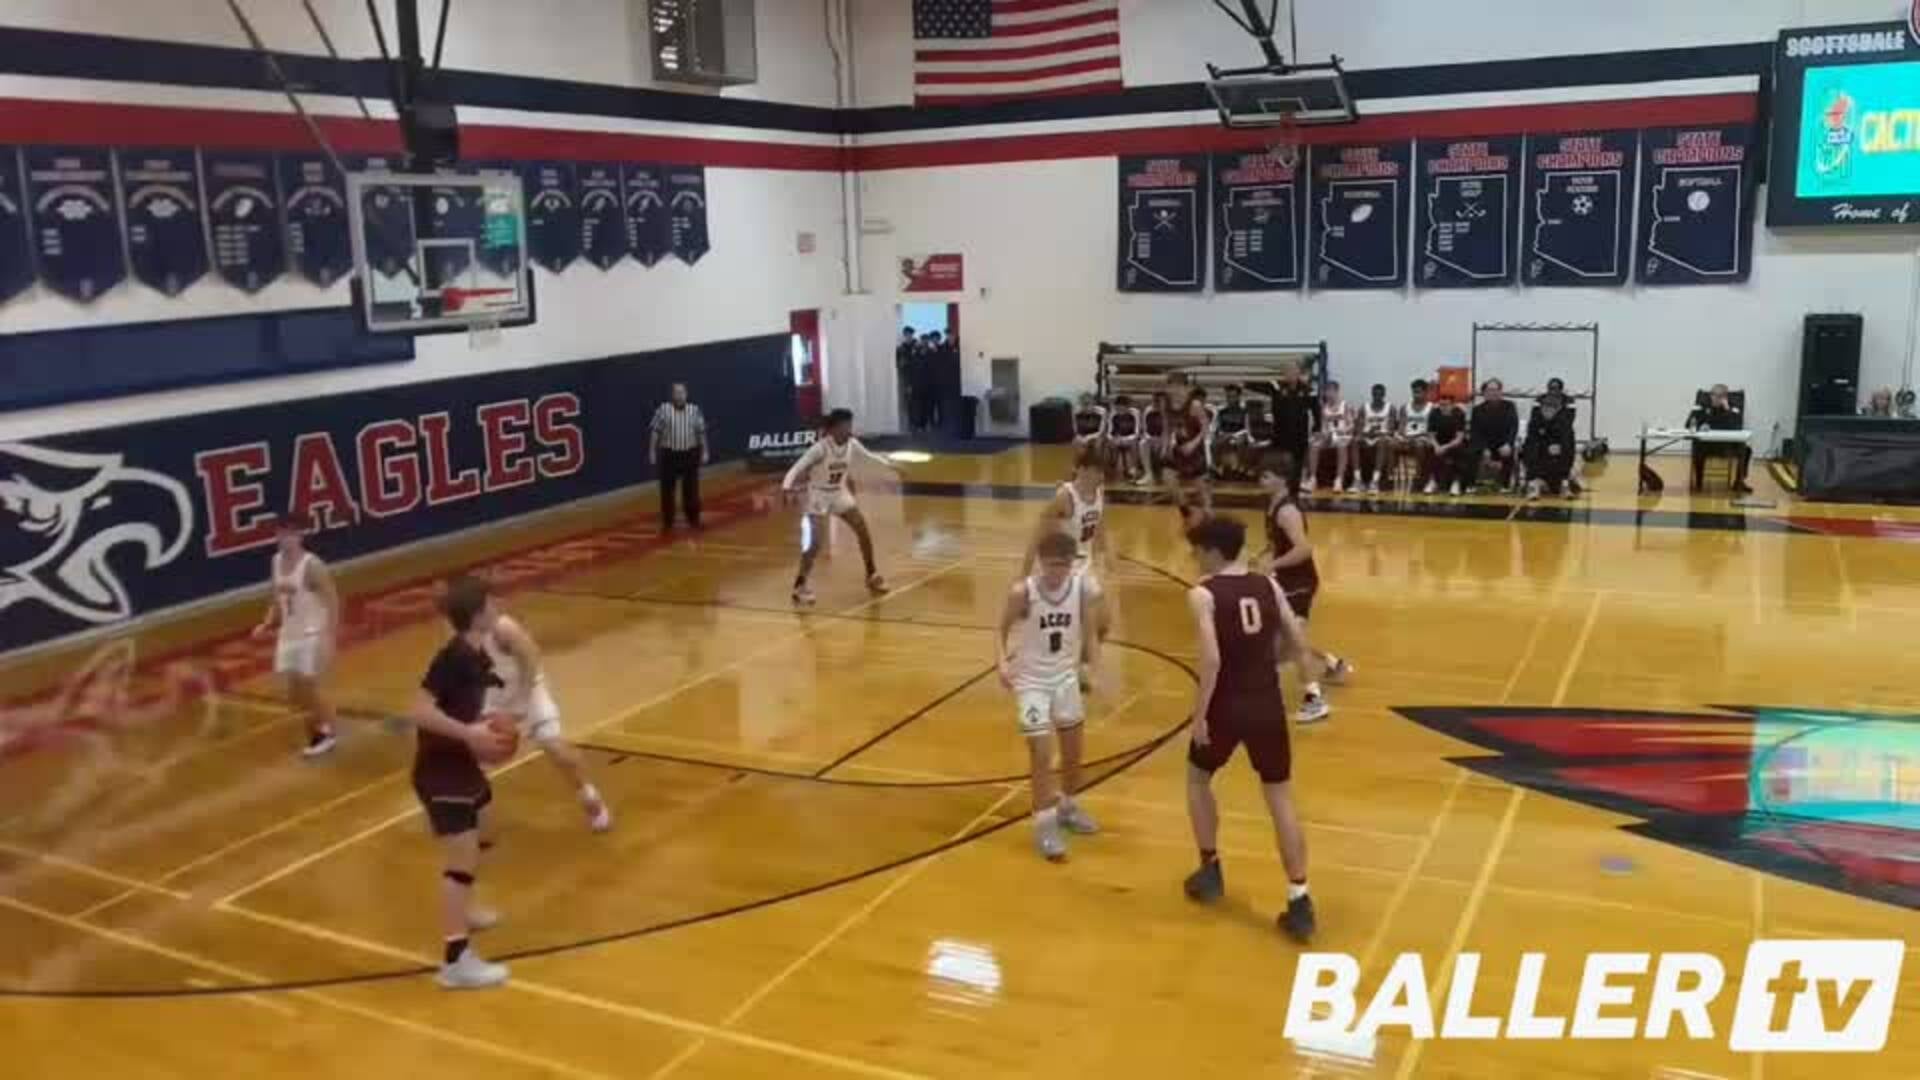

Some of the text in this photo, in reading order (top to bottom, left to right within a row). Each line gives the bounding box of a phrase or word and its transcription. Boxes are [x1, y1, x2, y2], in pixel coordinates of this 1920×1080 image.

[1785, 30, 1905, 57] SCOTTSDALE
[1537, 151, 1623, 170] CHAMPIONS
[1653, 145, 1744, 164] CHAMPIONS
[1832, 201, 1911, 222] Home of
[748, 430, 817, 449] BALLER
[194, 391, 584, 558] EAGLES
